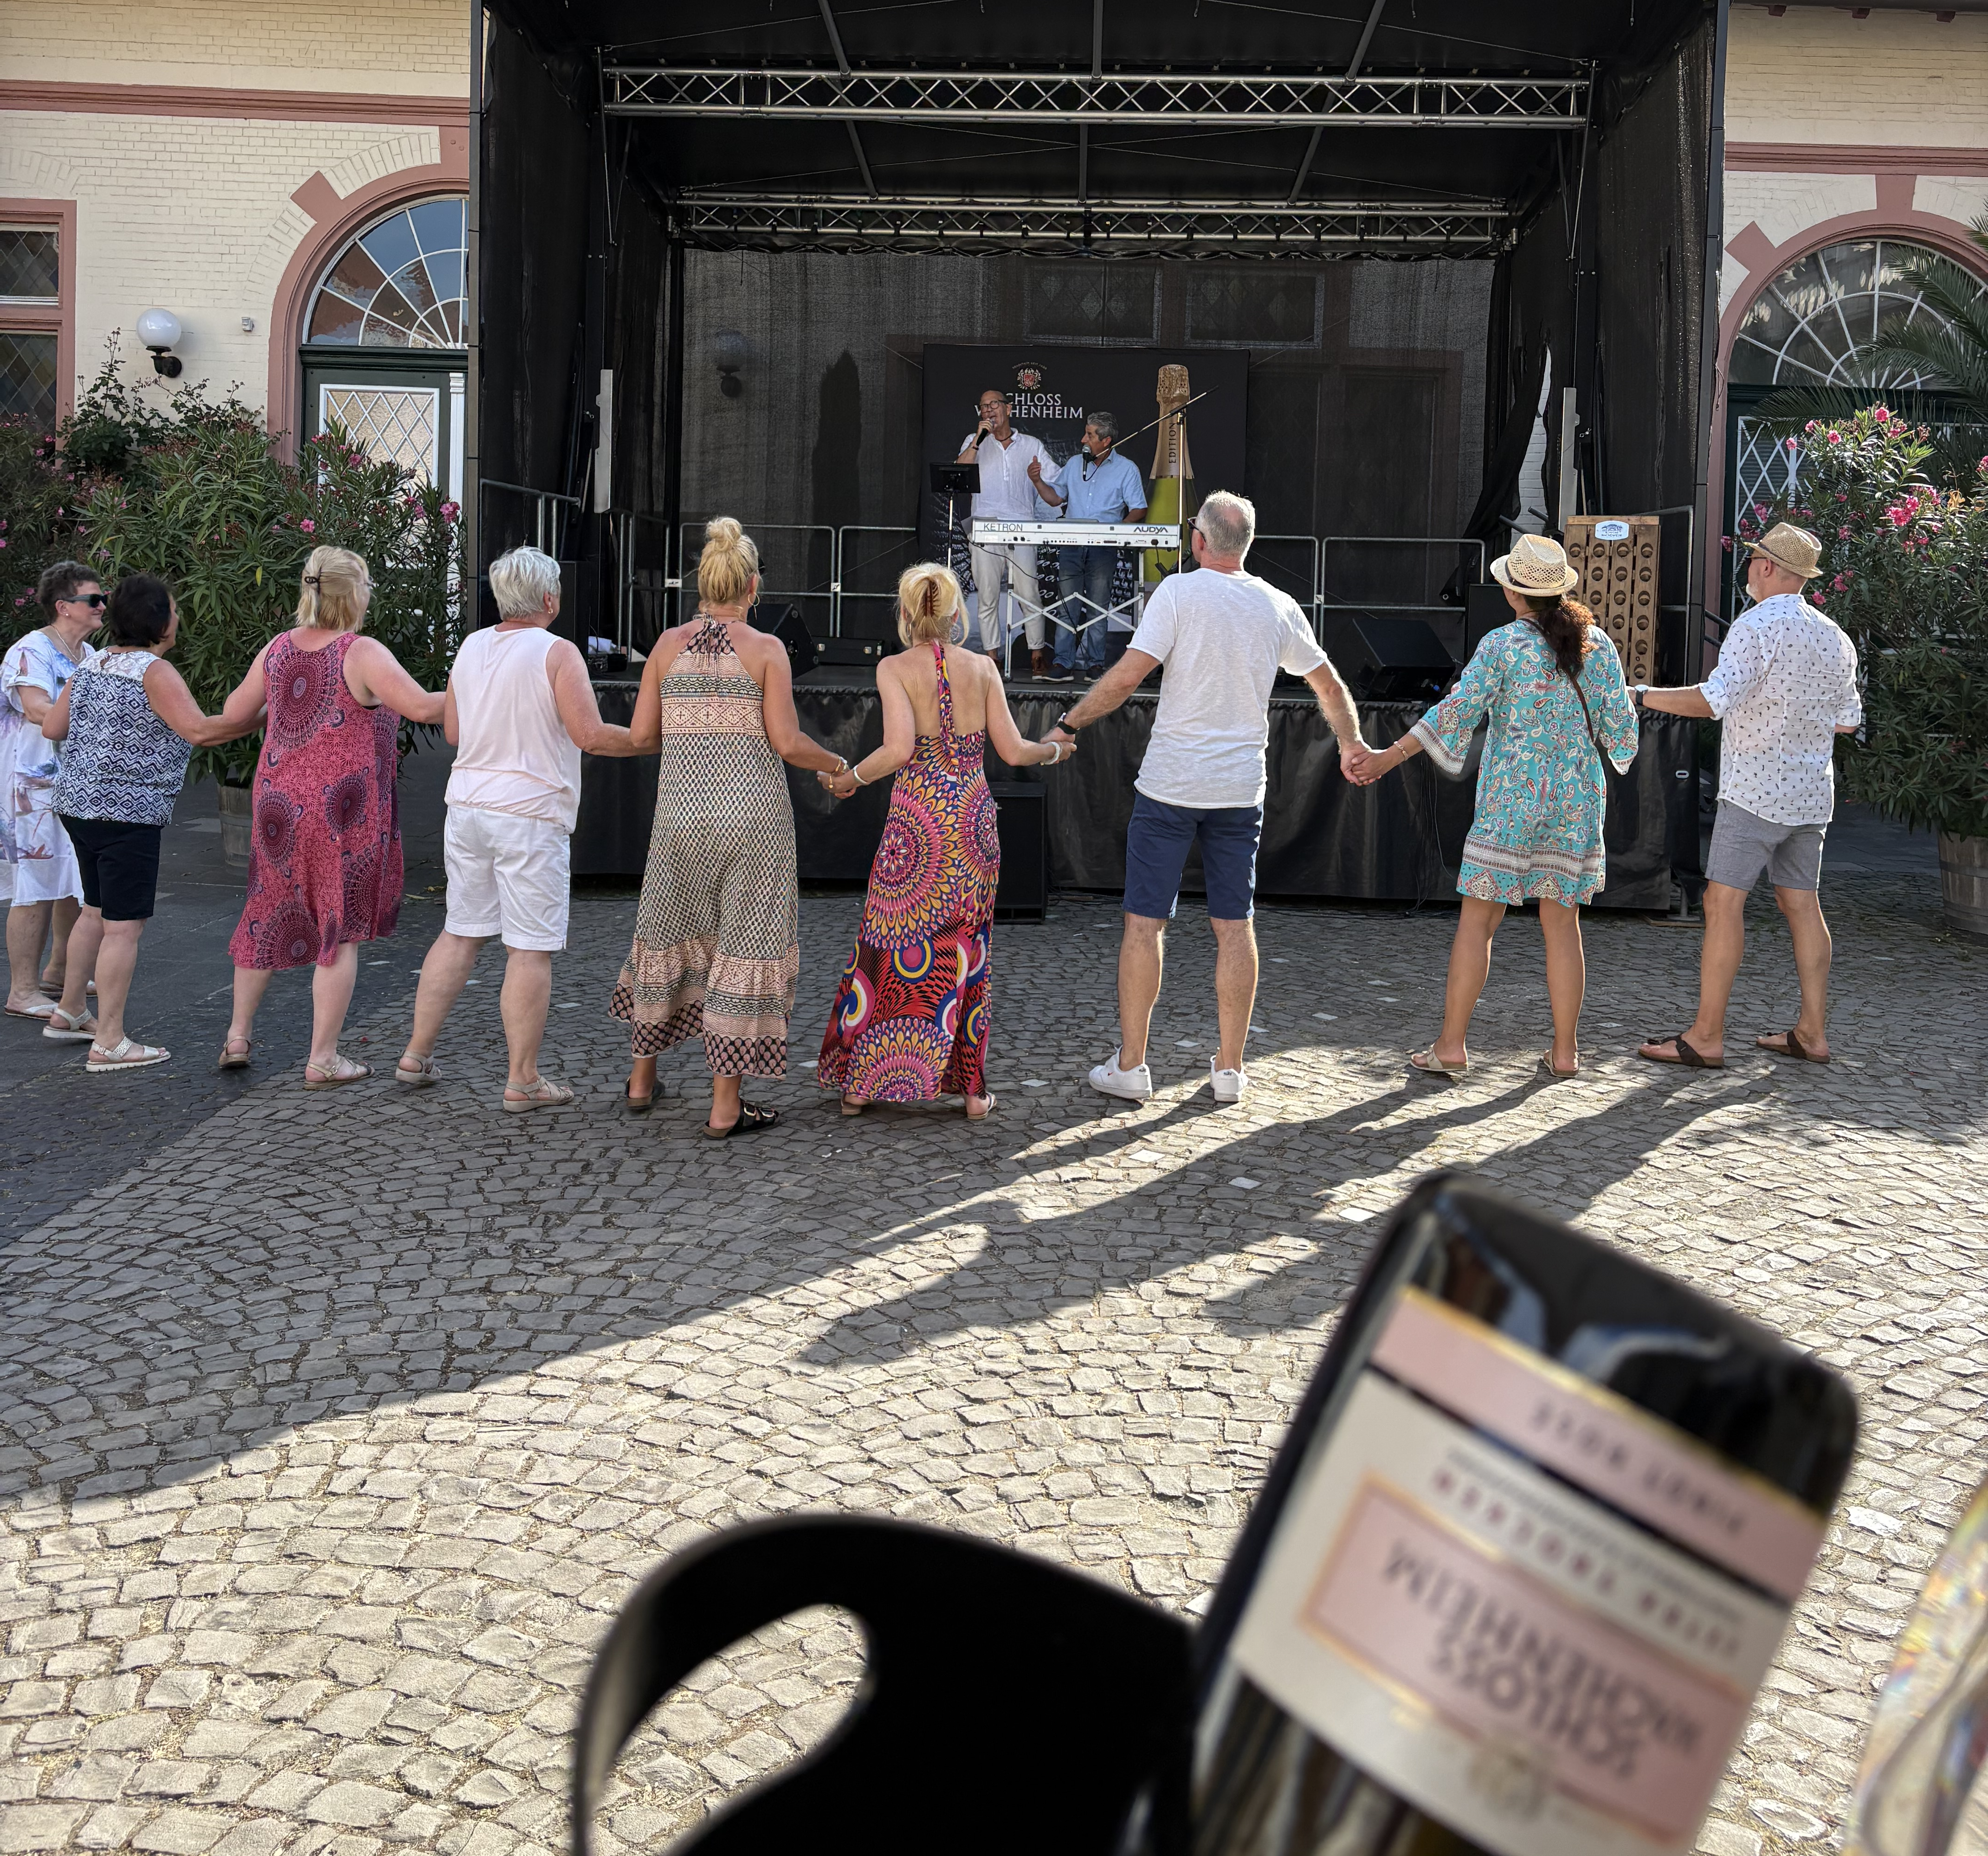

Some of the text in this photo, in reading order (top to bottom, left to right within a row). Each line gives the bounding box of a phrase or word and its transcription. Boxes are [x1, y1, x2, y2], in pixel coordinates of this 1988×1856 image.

[1006, 393, 1061, 406] CHLOSS
[975, 405, 1083, 419] HENHEIM
[984, 523, 1023, 531] KETRON
[1419, 1627, 1645, 1783] SCHLOSS
